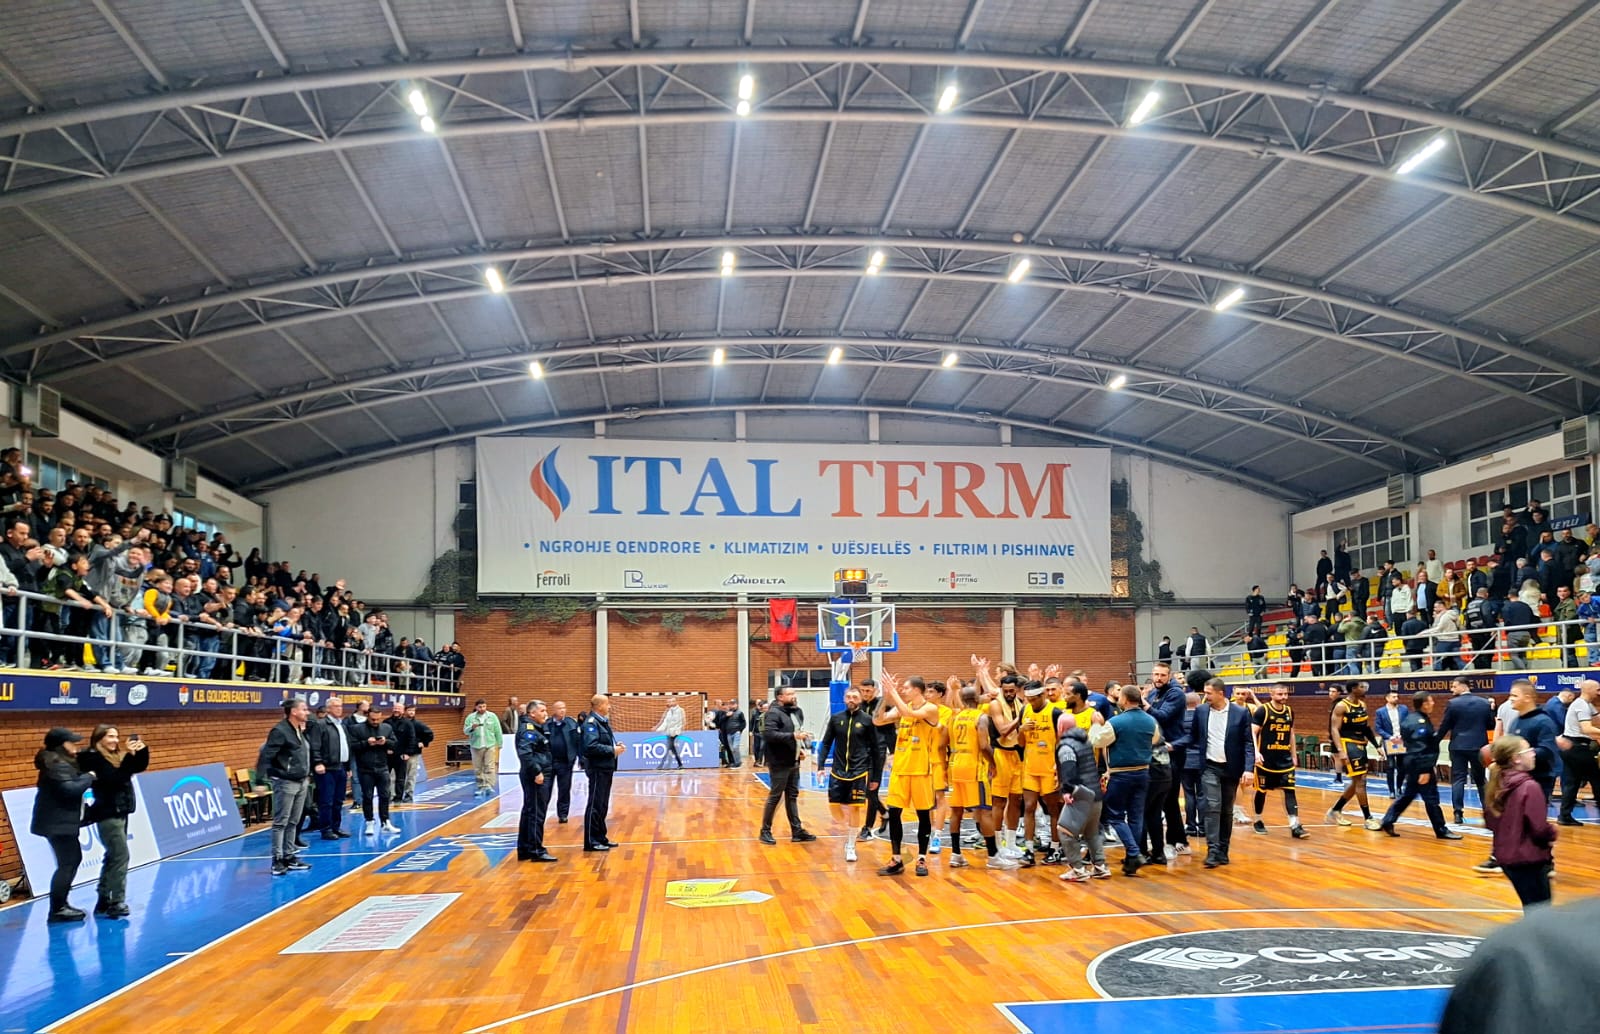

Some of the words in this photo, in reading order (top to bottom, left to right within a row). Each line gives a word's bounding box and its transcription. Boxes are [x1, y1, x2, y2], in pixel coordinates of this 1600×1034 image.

[588, 455, 802, 517] ITAL
[818, 459, 1072, 519] TERM
[539, 540, 611, 553] NGROHJE
[616, 541, 701, 554] QENDRORE
[724, 542, 809, 555] KLIMATIZIM
[832, 540, 912, 555] UJËSJELLËS
[933, 543, 988, 556] FILTRIM
[993, 544, 997, 555] I
[1002, 544, 1075, 557] PISHINAVE
[536, 573, 571, 589] Ferroli
[1404, 682, 1417, 691] K.B.
[1418, 681, 1447, 691] GOLDEN
[1476, 679, 1494, 689] YLLI
[632, 742, 703, 759] TROAL
[163, 787, 228, 829] TROCAL
